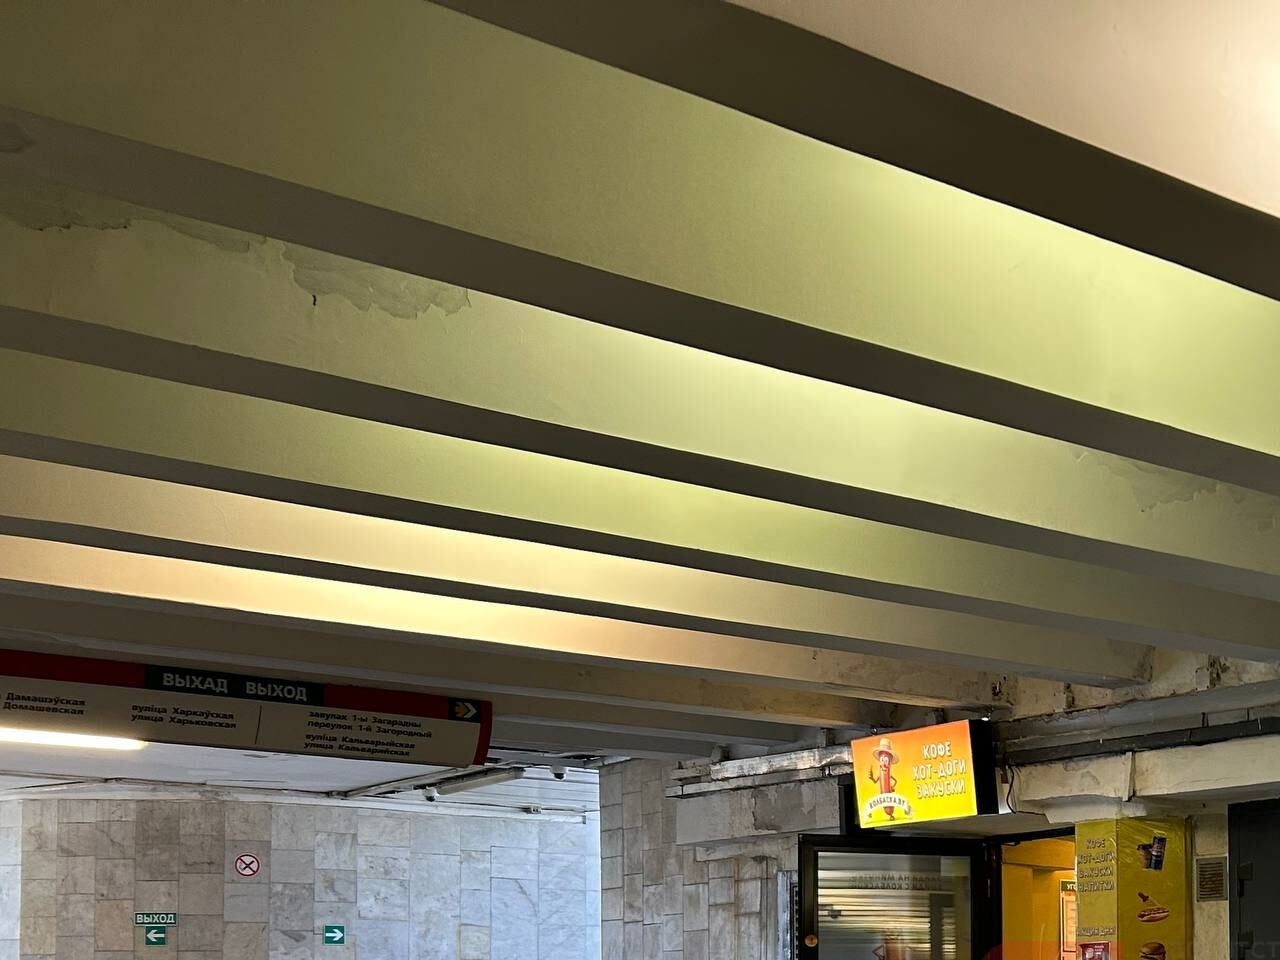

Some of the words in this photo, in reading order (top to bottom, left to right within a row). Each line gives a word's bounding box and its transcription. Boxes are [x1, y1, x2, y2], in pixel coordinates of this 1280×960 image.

[163, 673, 228, 693] ВЫХАД
[246, 681, 307, 701] ВЫХОД
[923, 741, 951, 759] КОФЕ
[913, 760, 967, 780] ХОТ-ДОГИ
[916, 780, 966, 799] ЗАКУСКИ
[136, 914, 175, 923] ВЫХОД
